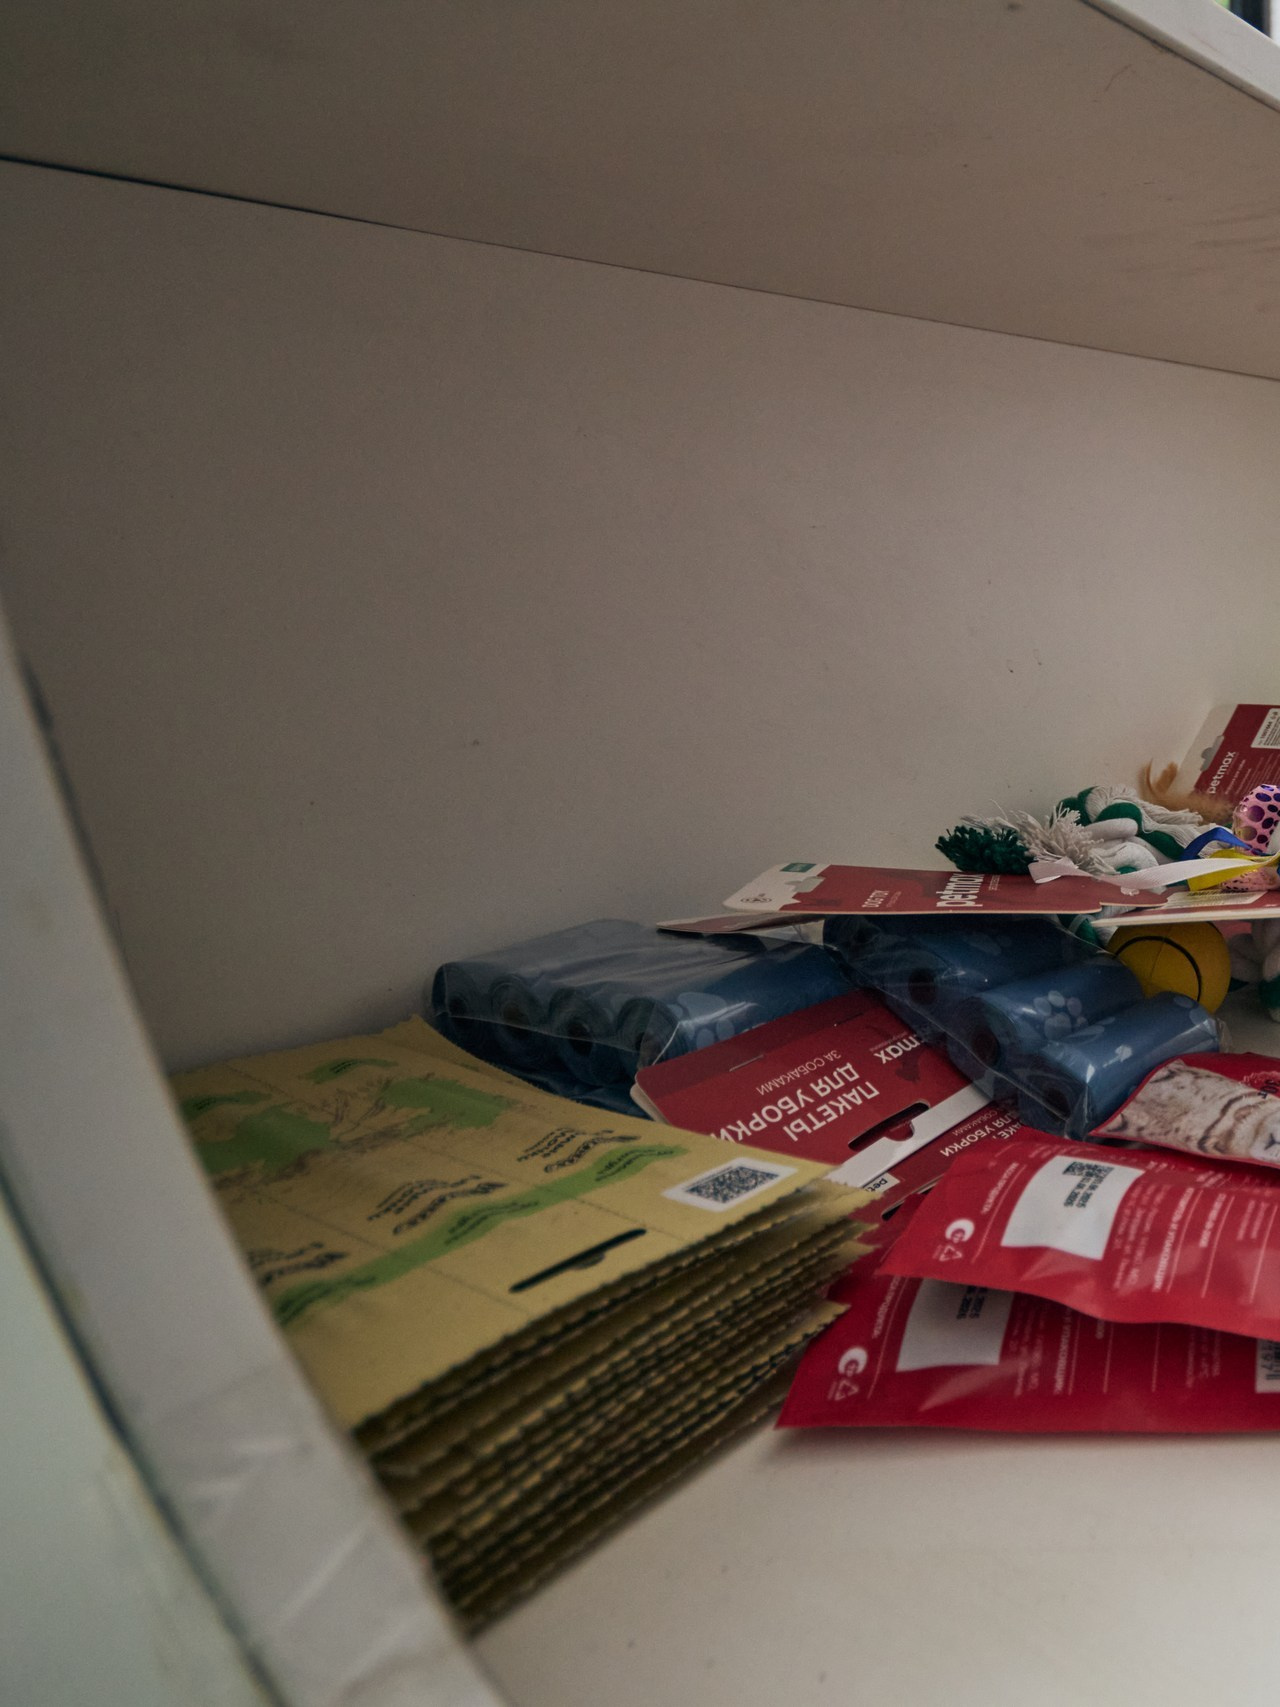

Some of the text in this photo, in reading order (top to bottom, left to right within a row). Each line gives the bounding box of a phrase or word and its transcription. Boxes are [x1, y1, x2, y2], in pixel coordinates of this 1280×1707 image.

[1207, 752, 1236, 794] petmax
[936, 873, 985, 907] petmax
[873, 1034, 921, 1065] max
[755, 1050, 842, 1096] ЗА СОБАКАМИ
[811, 1062, 861, 1098] ДЛЯ
[788, 1080, 881, 1142] ПАКЕТЫ
[952, 1110, 998, 1136] СОБАКАМИ
[939, 1125, 995, 1157] УБОРКИ
[866, 1177, 888, 1193] pet
